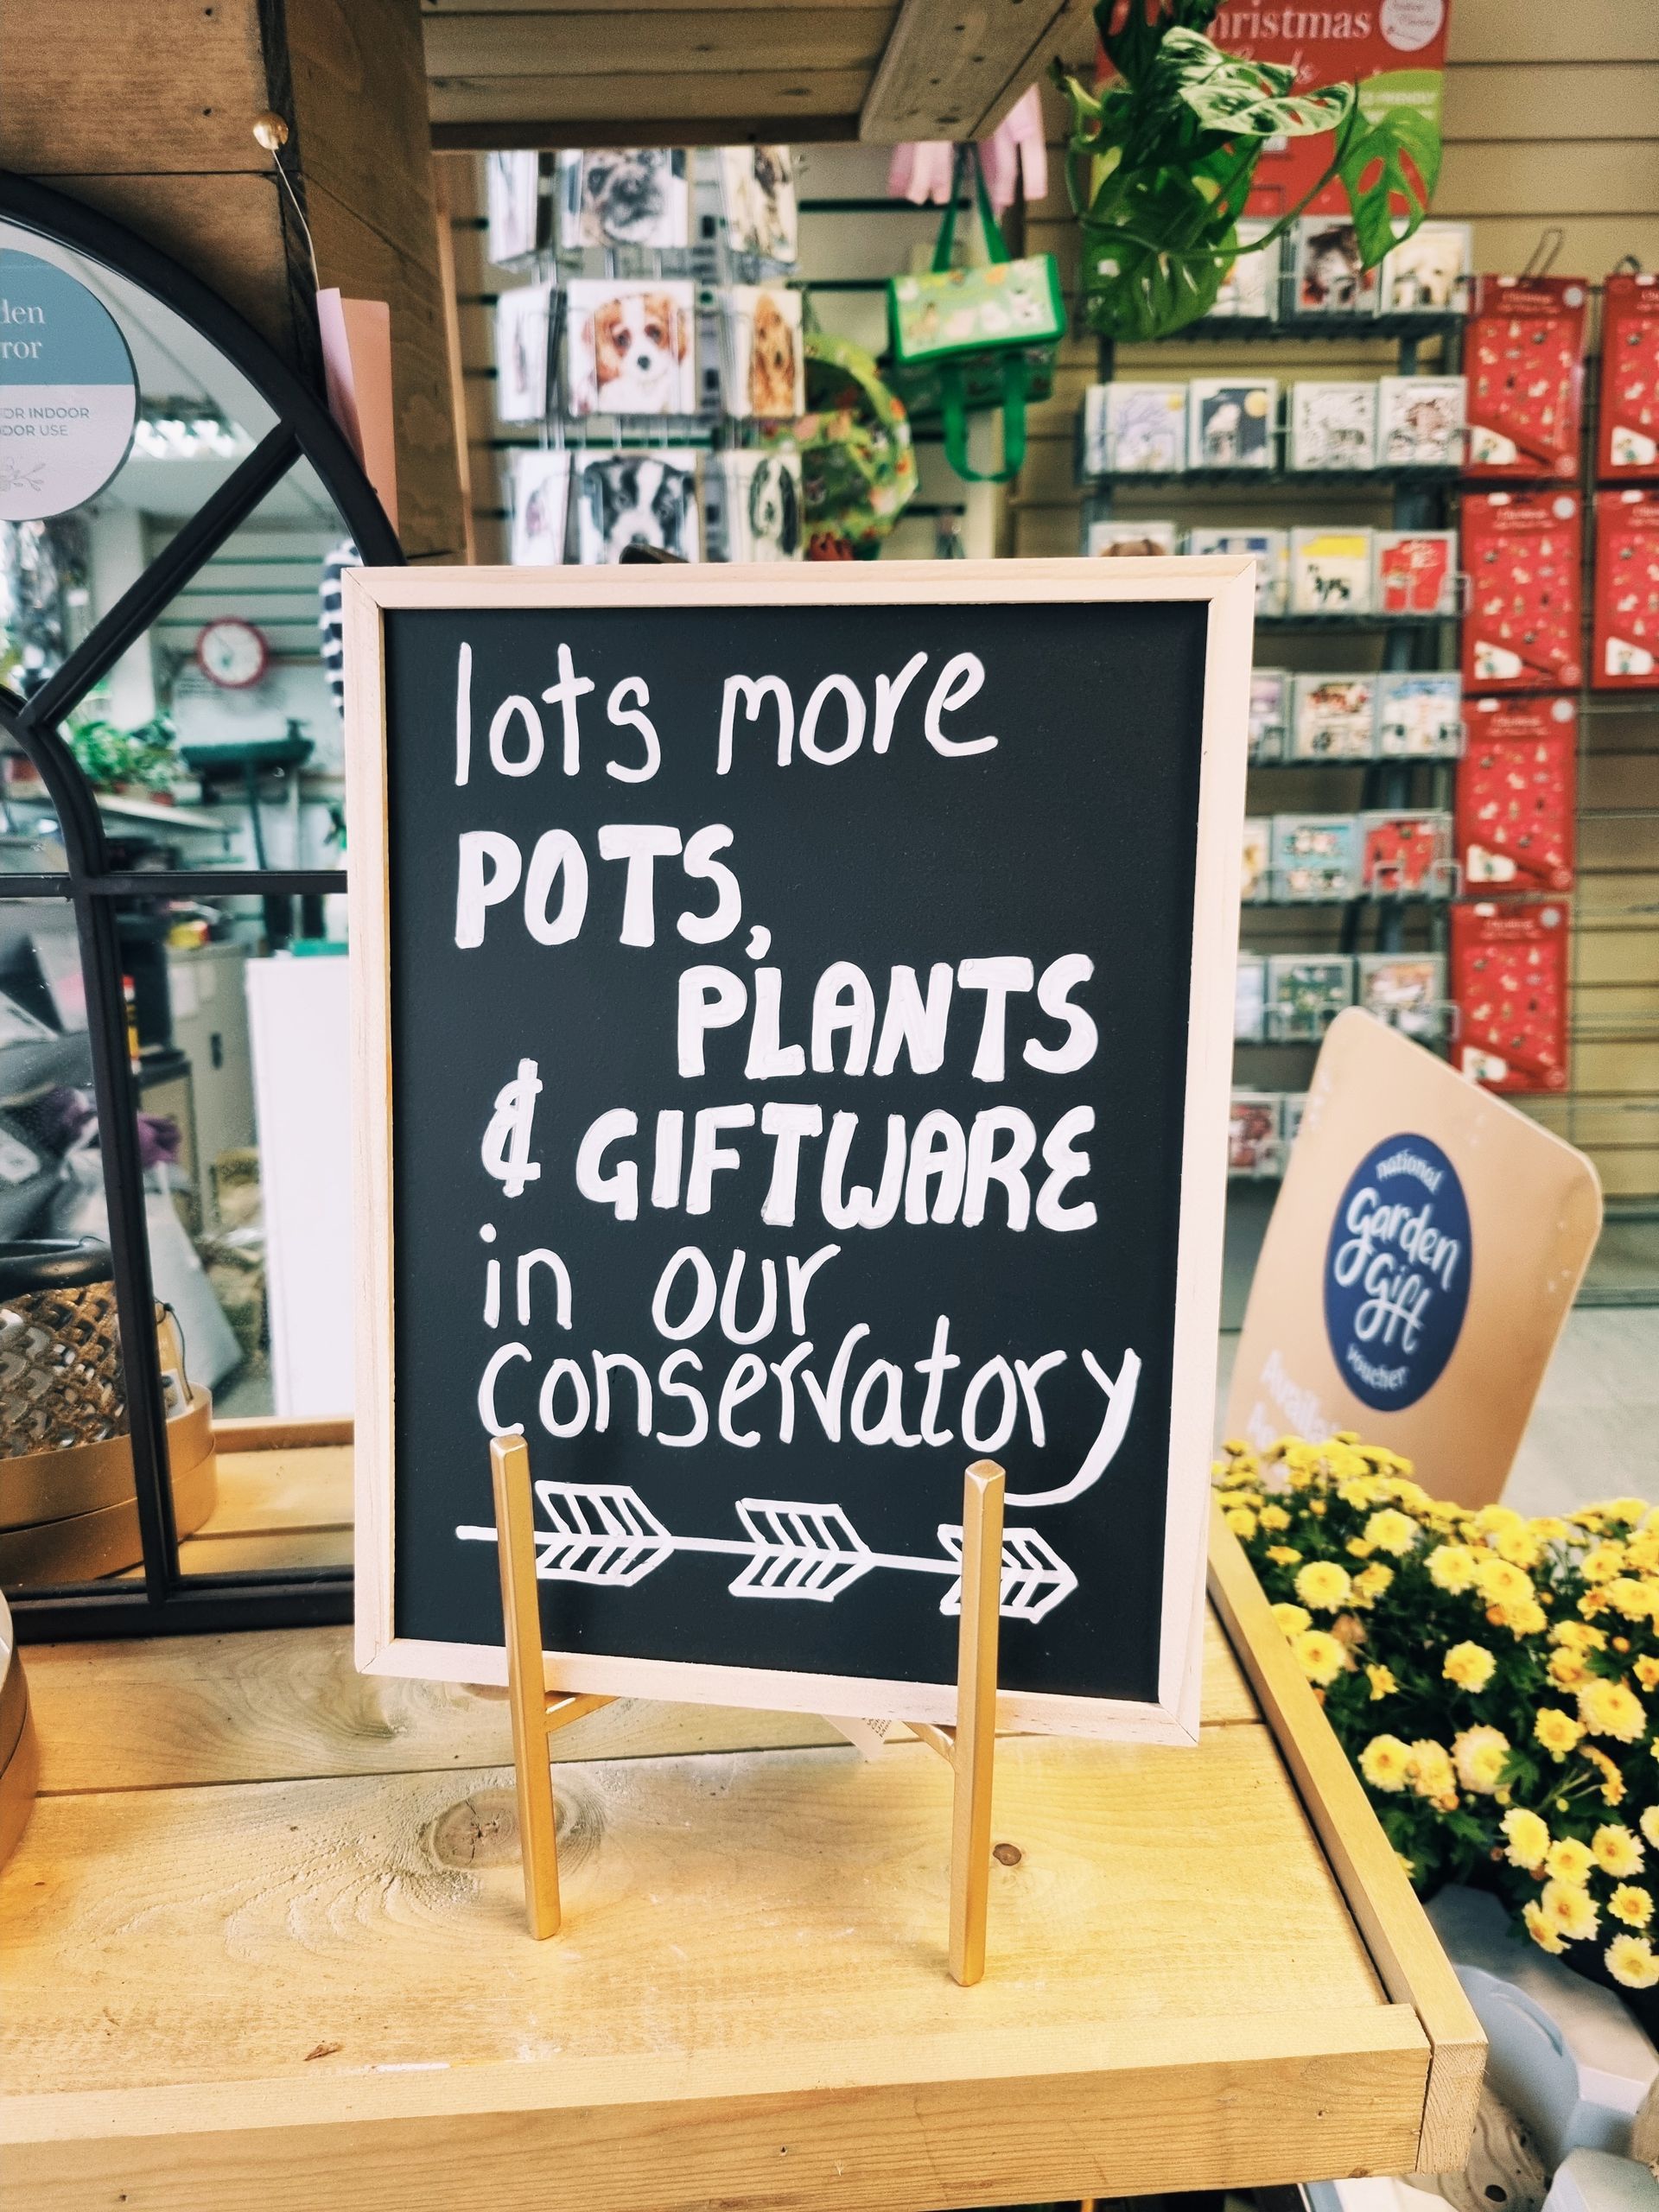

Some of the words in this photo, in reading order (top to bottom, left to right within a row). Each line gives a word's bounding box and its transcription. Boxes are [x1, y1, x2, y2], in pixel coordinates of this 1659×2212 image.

[1206, 0, 1372, 40] hristmas
[29, 407, 90, 419] INDOOR
[40, 424, 68, 436] USE
[454, 641, 661, 787] lots
[715, 651, 999, 776] more
[454, 823, 772, 961] POTS,
[677, 953, 1099, 1084] PLANTS
[480, 1057, 543, 1198] &
[575, 1102, 1099, 1232] GIFTWARE
[479, 1223, 572, 1331] in
[651, 1243, 842, 1345] our
